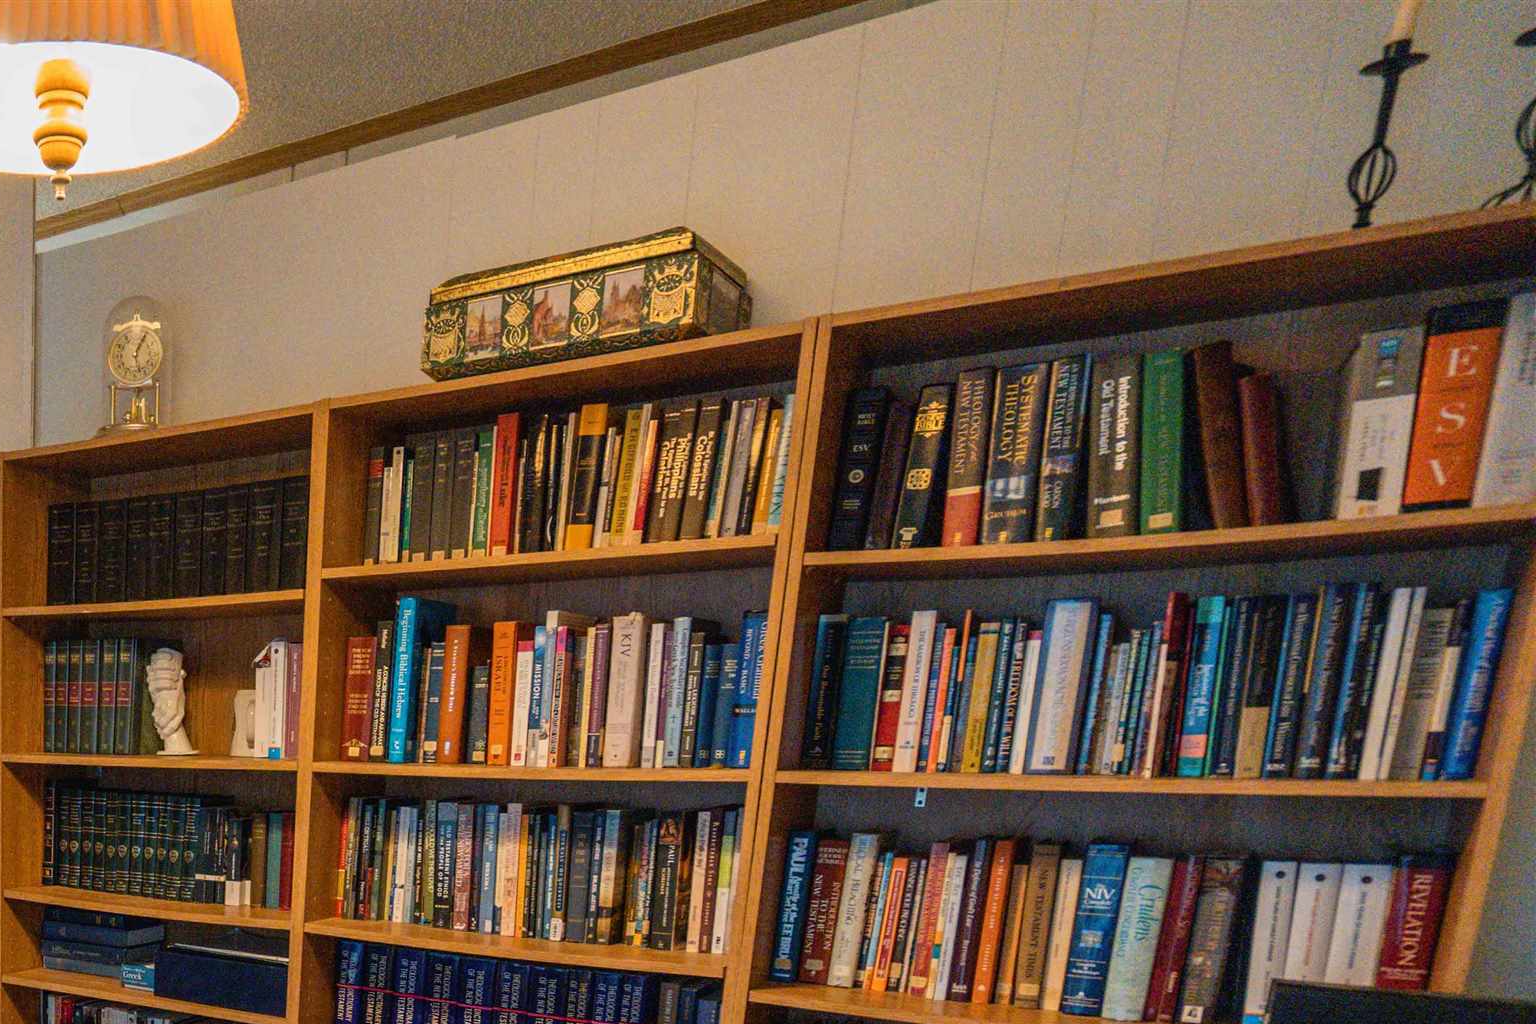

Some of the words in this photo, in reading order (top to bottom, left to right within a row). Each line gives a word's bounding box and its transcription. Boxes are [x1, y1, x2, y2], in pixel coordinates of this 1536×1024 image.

[1102, 380, 1115, 398] Old
[998, 383, 1020, 462] THEOLOGY
[1015, 374, 1038, 464] SYSTEMATIC
[1050, 392, 1068, 449] TESTAMENT
[1116, 376, 1132, 438] Introduction
[1099, 401, 1113, 455] Testament
[1116, 440, 1128, 451] to
[668, 438, 688, 498] Philippians
[689, 436, 707, 496] Colossians
[1115, 453, 1127, 470] the
[399, 609, 412, 652] Beginning
[619, 634, 632, 656] KJV
[397, 654, 409, 685] Biblical
[533, 664, 542, 699] MISSION
[396, 688, 405, 718] Hebrew
[790, 837, 808, 875] PAUL
[1085, 887, 1116, 901] NIV
[1396, 875, 1433, 966] REVELATION
[337, 987, 346, 1021] TESTAMENT
[345, 988, 354, 1022] DICTIONARY
[365, 990, 375, 1024] TESTAMENT
